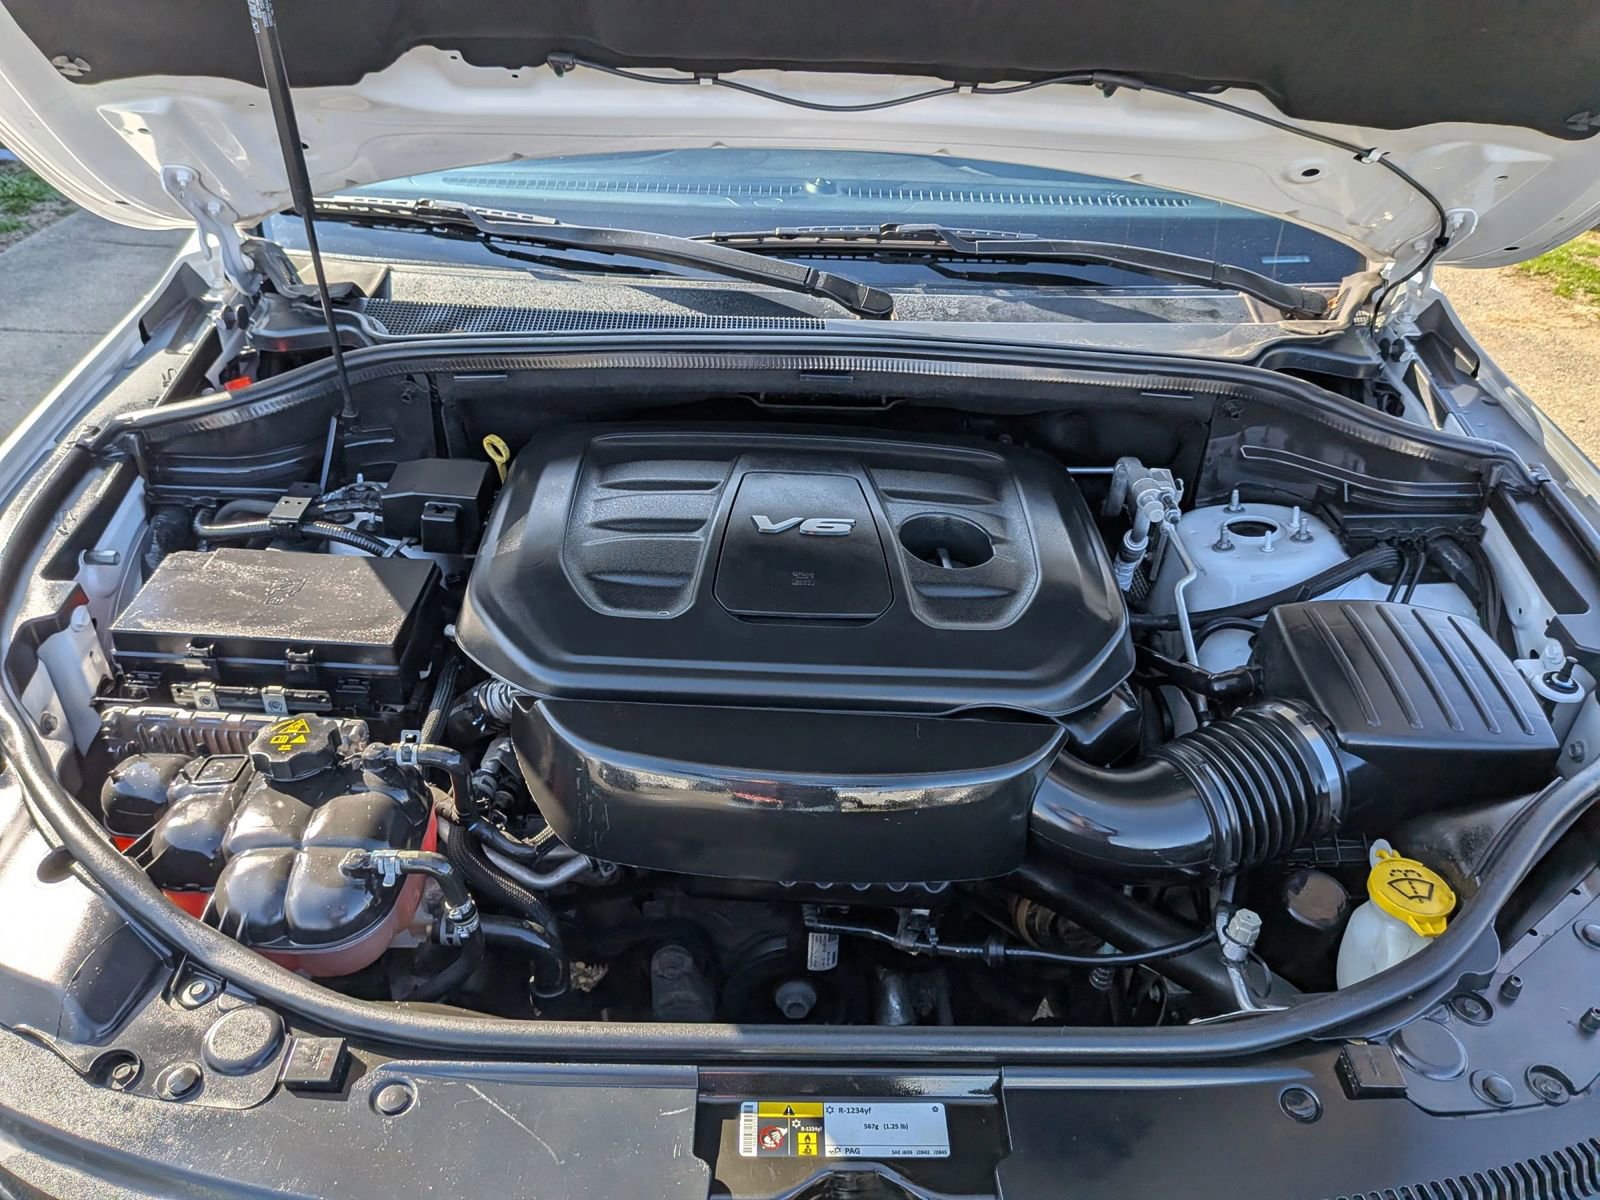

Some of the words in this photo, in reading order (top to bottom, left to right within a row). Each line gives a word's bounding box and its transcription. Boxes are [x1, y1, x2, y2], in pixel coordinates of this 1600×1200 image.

[751, 514, 857, 537] V6
[838, 1106, 872, 1115] R-1234yf
[863, 1123, 879, 1131] 567g
[883, 1123, 899, 1131] (1.25
[900, 1123, 909, 1131] lb)
[844, 1147, 861, 1155] PAG
